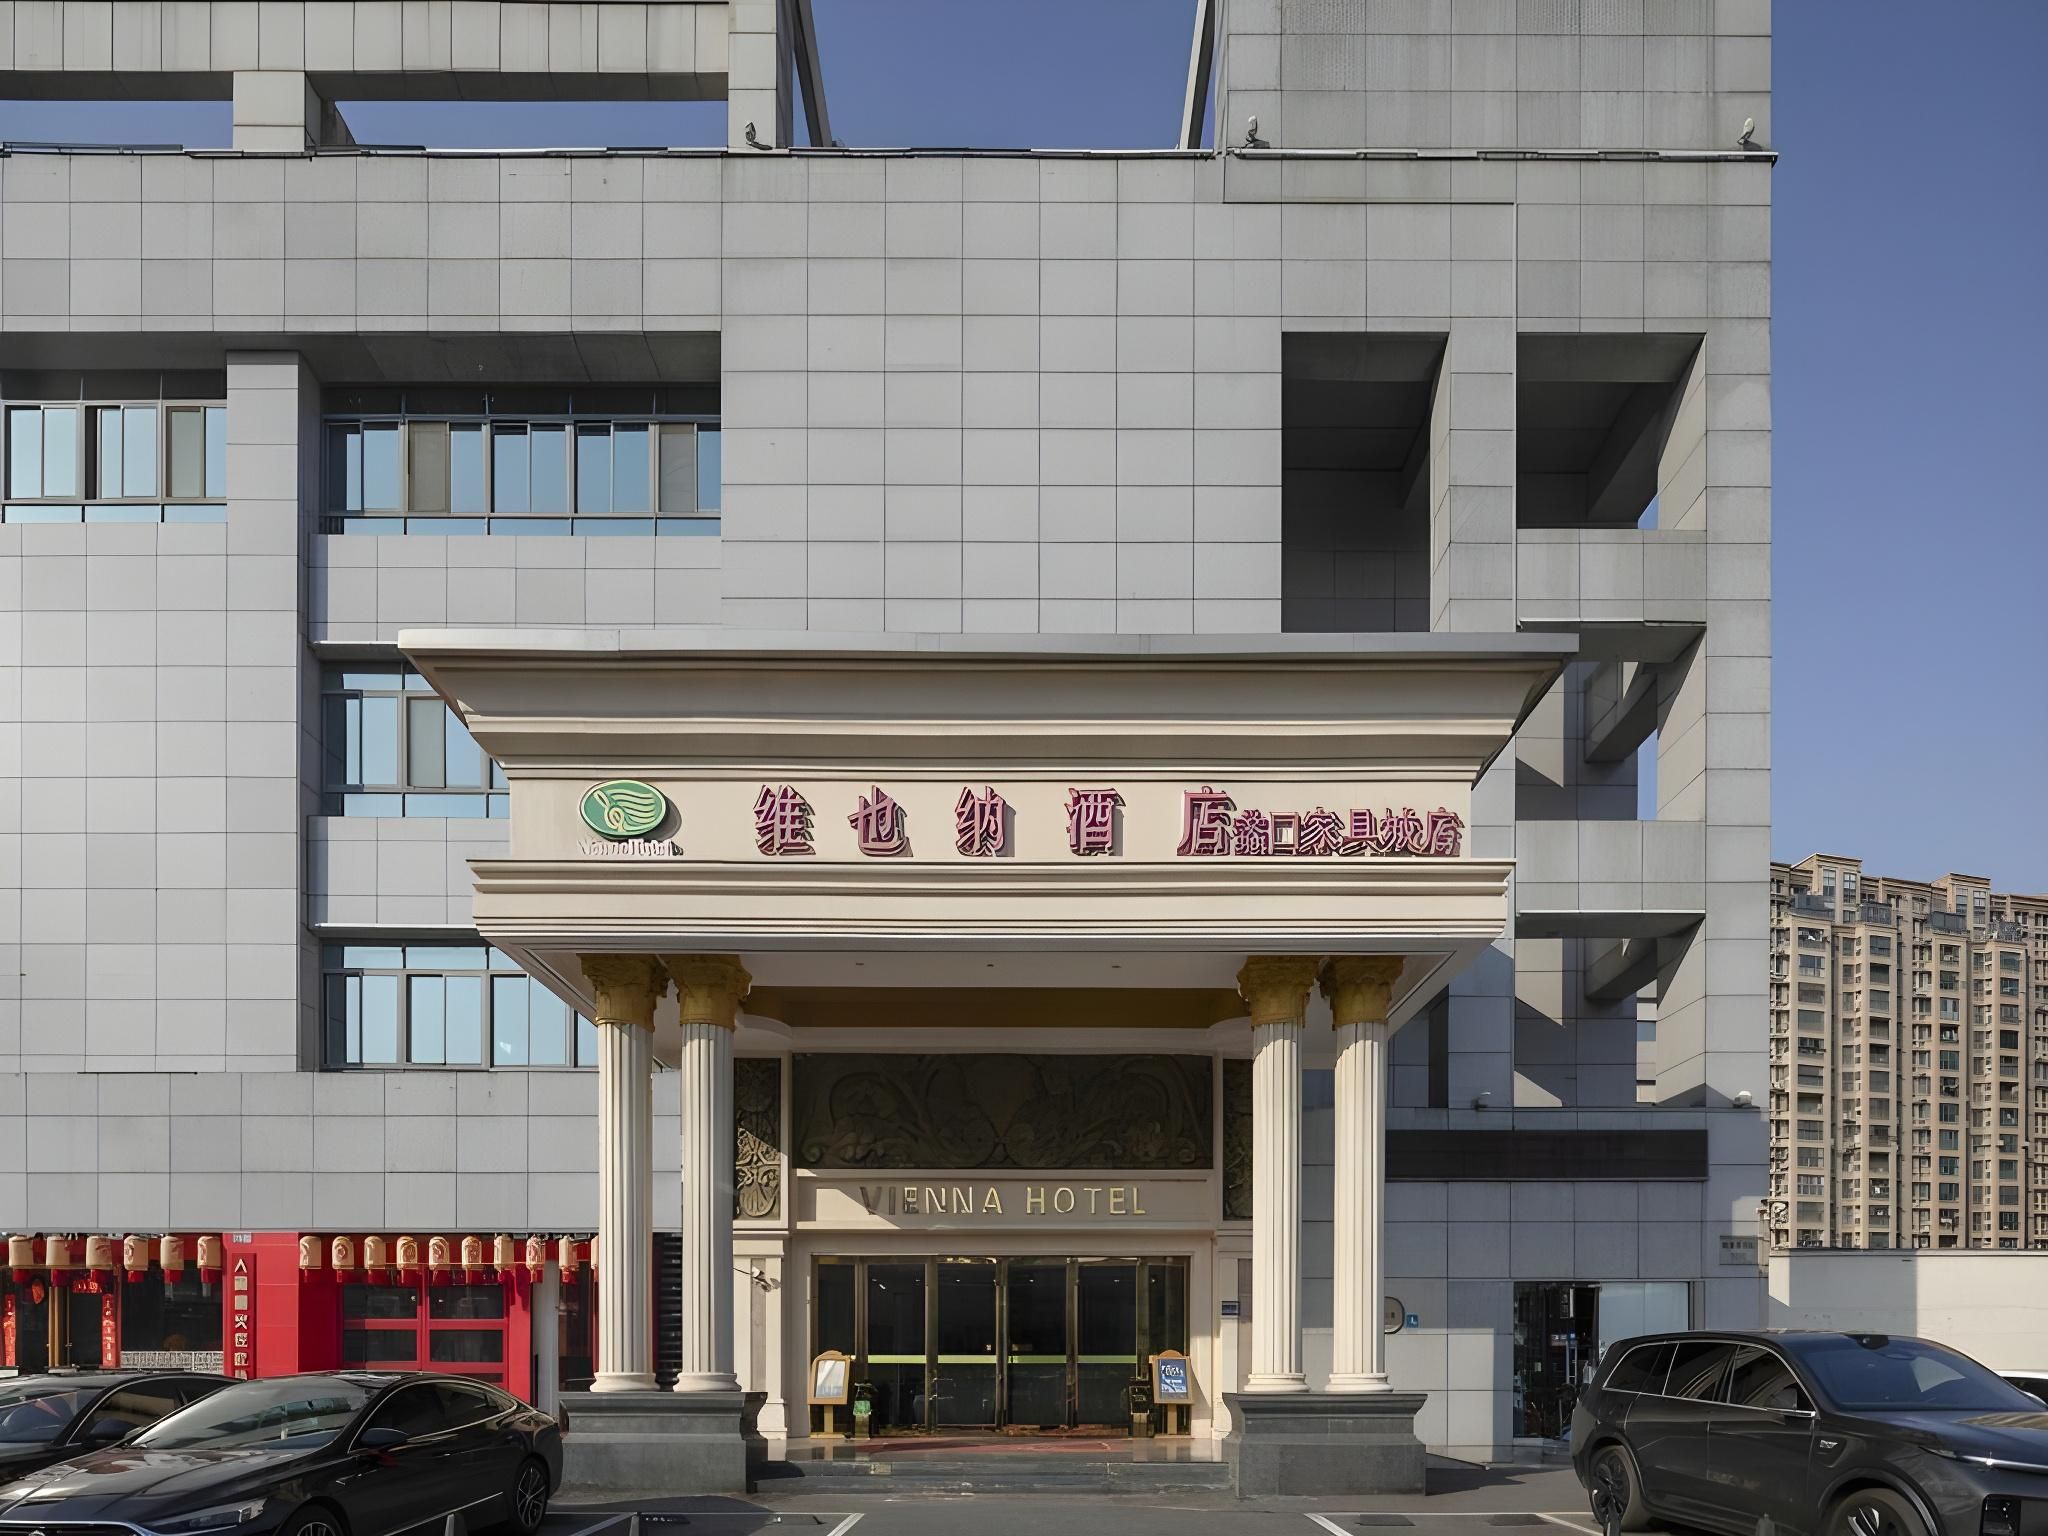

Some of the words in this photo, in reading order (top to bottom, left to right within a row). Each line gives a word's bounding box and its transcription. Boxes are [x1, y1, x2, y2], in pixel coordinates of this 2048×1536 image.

[753, 784, 1235, 857] 维也纳酒店
[859, 1186, 1003, 1215] VIENNA
[1026, 1186, 1146, 1215] HOTEL
